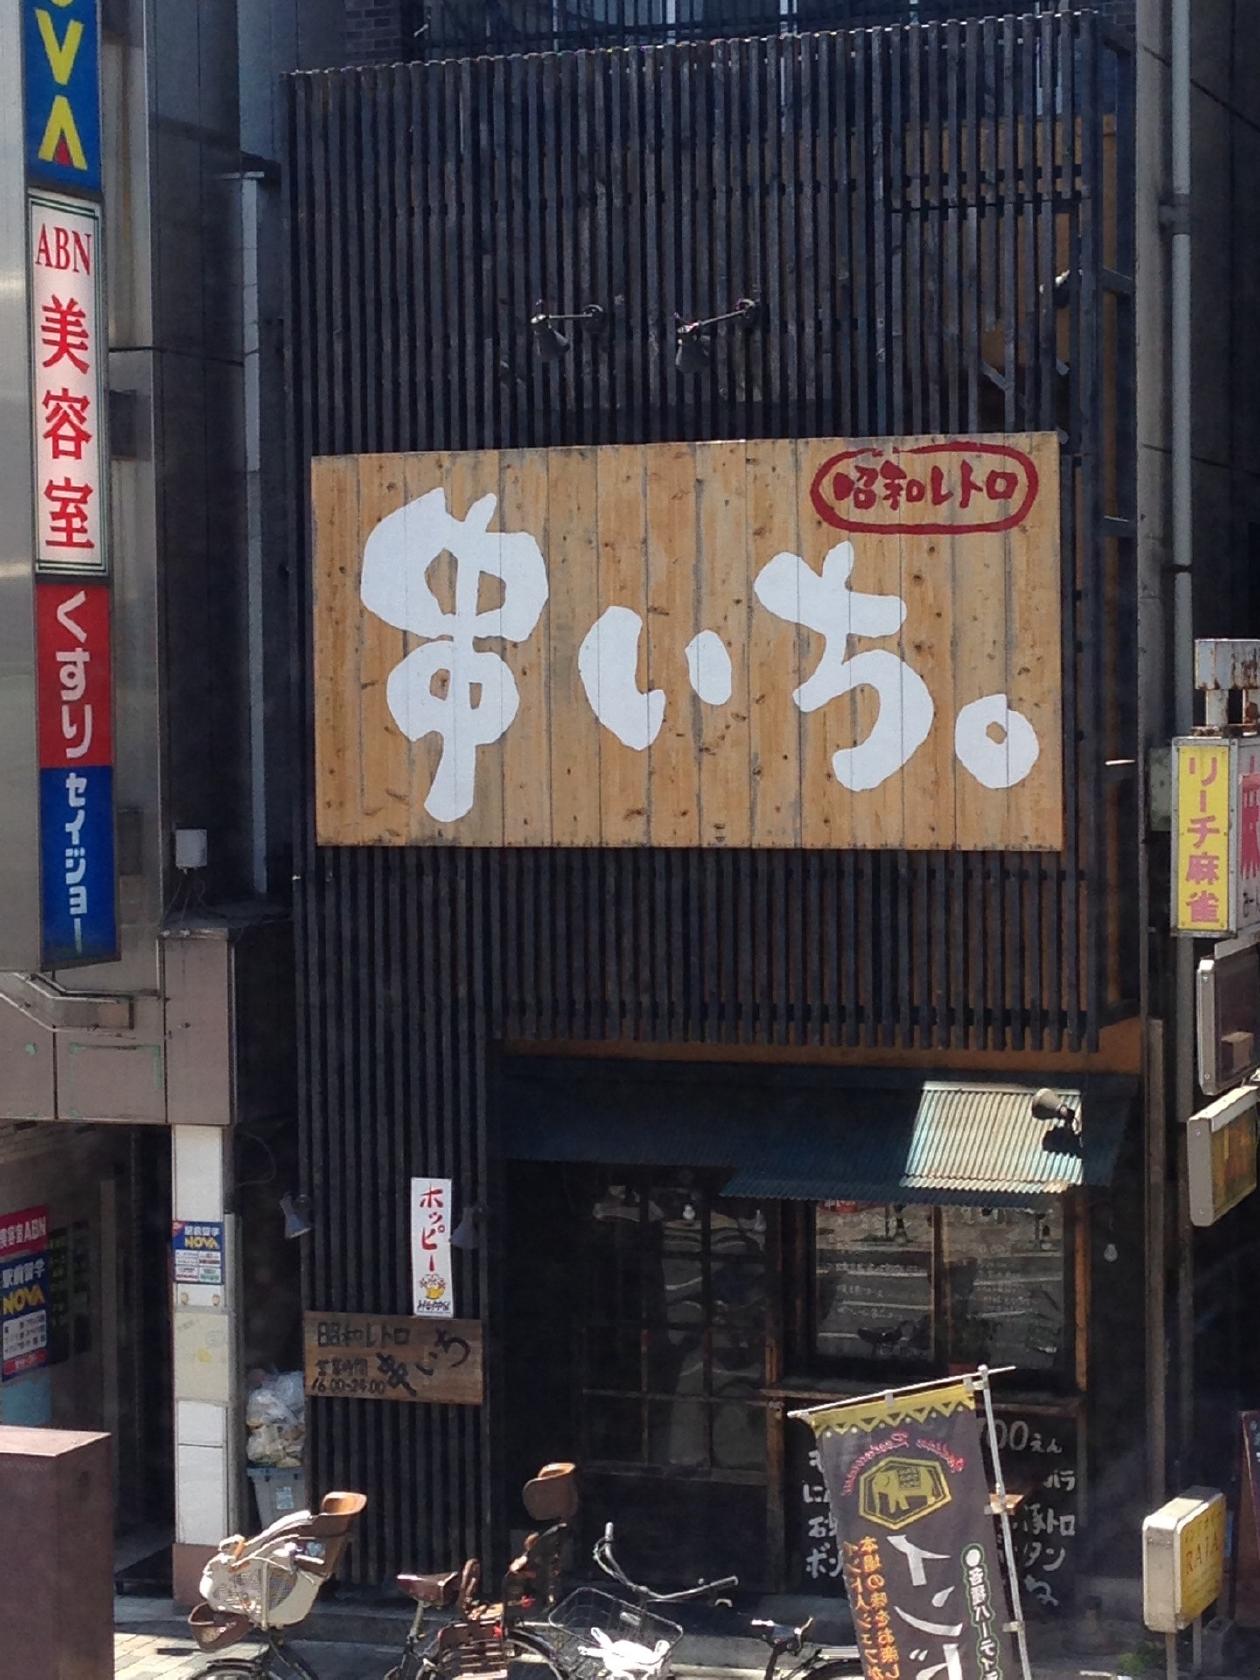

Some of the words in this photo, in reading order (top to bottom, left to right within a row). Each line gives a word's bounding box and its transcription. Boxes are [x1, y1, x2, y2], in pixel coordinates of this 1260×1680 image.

[34, 0, 88, 171] VA
[35, 223, 92, 275] ABN
[40, 294, 95, 549] 美容室
[832, 459, 1020, 511] 昭和レトロ
[55, 590, 93, 759] くすり
[64, 772, 88, 953] セイジョー
[1186, 756, 1221, 923] リーチ麻雀
[184, 1236, 220, 1249] NOVA
[419, 1183, 446, 1272] ホッピー
[2, 1284, 45, 1315] NOVA
[317, 1321, 411, 1348] 昭和レトロ
